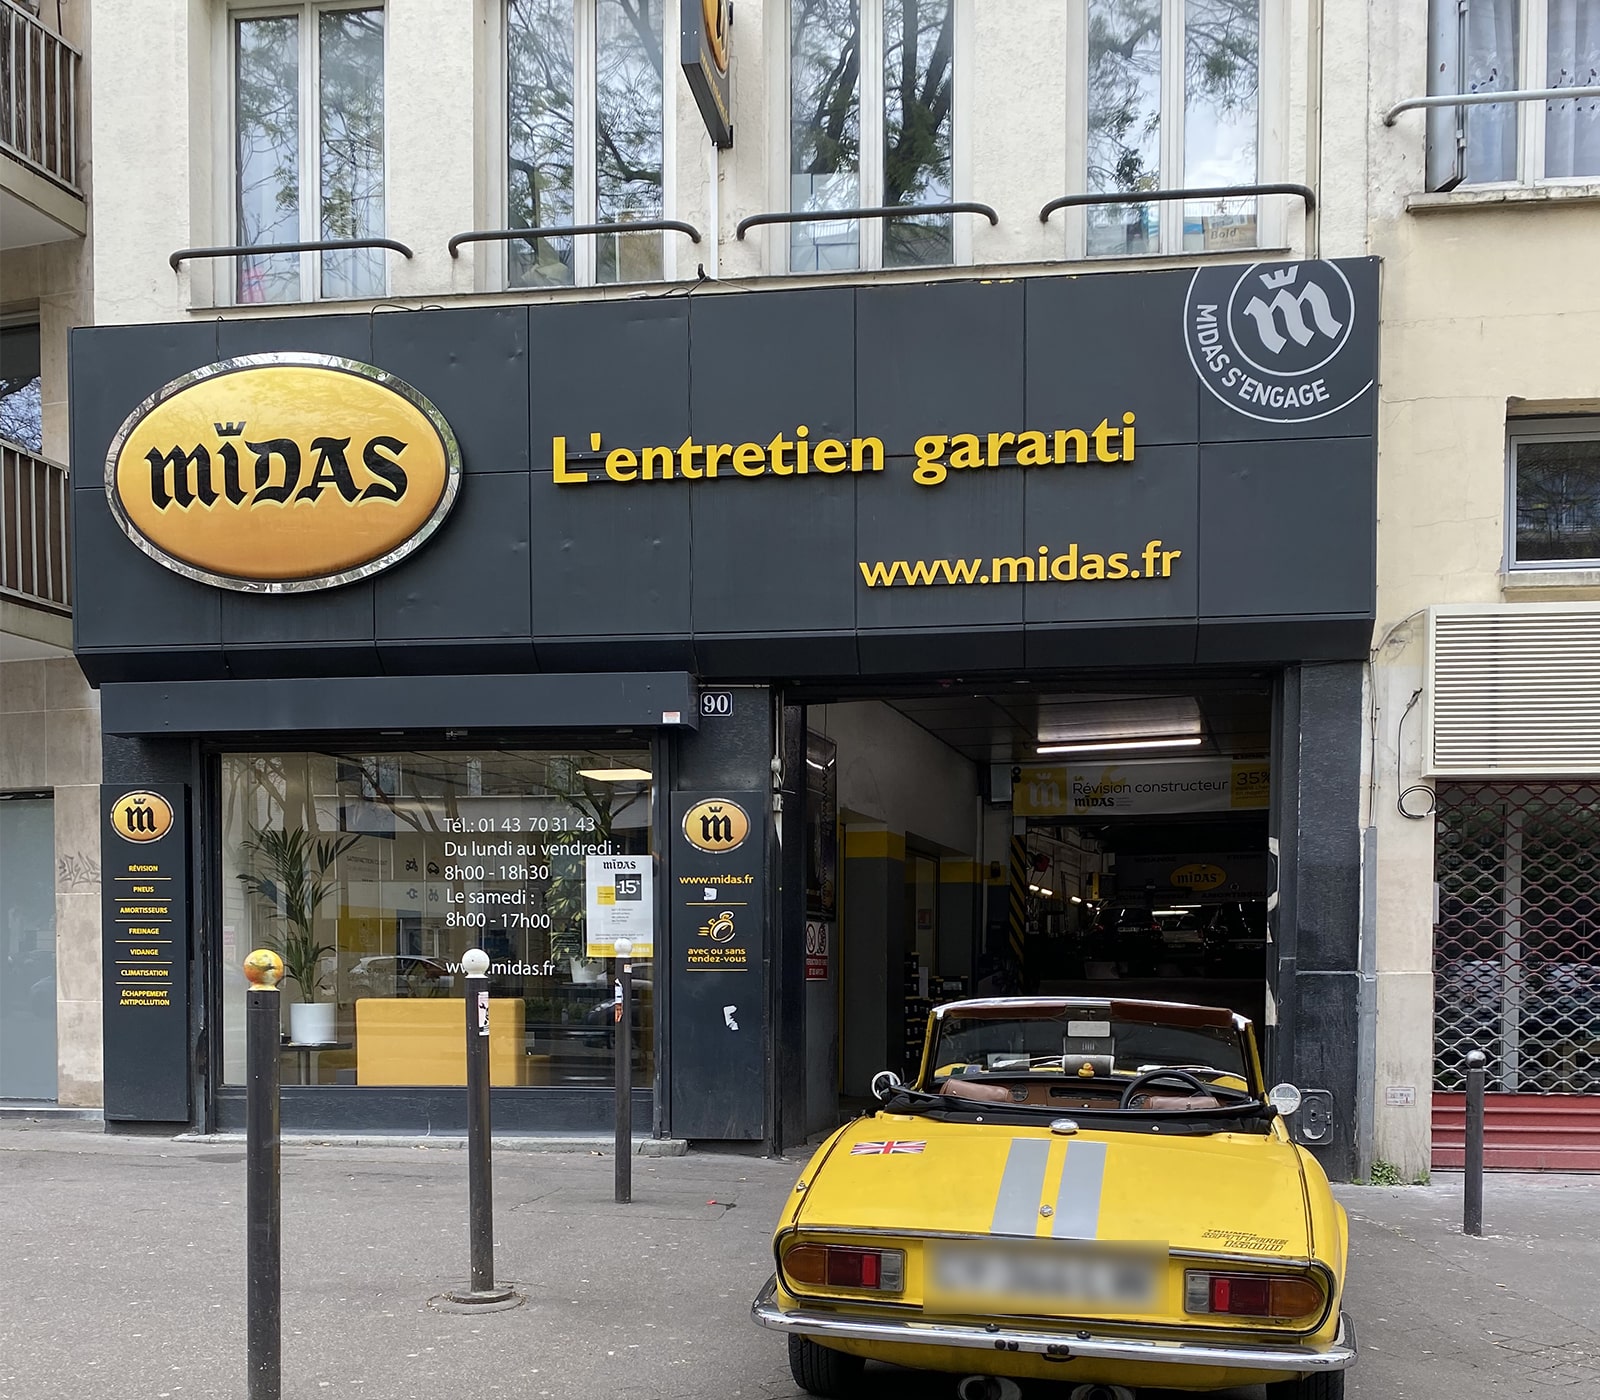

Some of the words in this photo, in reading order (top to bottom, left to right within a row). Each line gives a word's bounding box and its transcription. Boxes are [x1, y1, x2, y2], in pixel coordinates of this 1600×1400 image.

[1196, 304, 1230, 373] MIDAS
[1221, 367, 1330, 408] S'ENGAGE
[552, 425, 886, 484] L'entretien
[913, 411, 1136, 486] garanti
[859, 540, 1182, 588] www.midas.fr
[703, 695, 728, 713] 90
[1073, 781, 1132, 795] Révision
[1135, 779, 1229, 794] constructeur
[479, 817, 494, 833] 01
[501, 817, 521, 832] 43
[529, 817, 548, 832] 70
[552, 817, 567, 832] 31
[575, 817, 595, 832] 43
[445, 841, 467, 857] Du
[472, 840, 512, 857] lundi
[517, 845, 536, 857] au
[540, 839, 612, 856] vendredi
[128, 864, 159, 872] RÉVISION
[444, 865, 484, 881] 8h00
[500, 865, 549, 881] 18h30
[679, 874, 754, 885] www.midas.fr
[446, 888, 464, 904] Le
[468, 889, 527, 904] samedi
[446, 912, 486, 928] 8h00
[501, 913, 550, 929] 17h00
[128, 927, 160, 935] FREINAGE
[129, 948, 159, 956] VIDANGE
[687, 955, 747, 963] rendez-vous
[120, 969, 169, 977] CLIMATISATION
[446, 960, 556, 976] ww.midas.fr
[121, 989, 168, 997] ÉCHAPPEMENT
